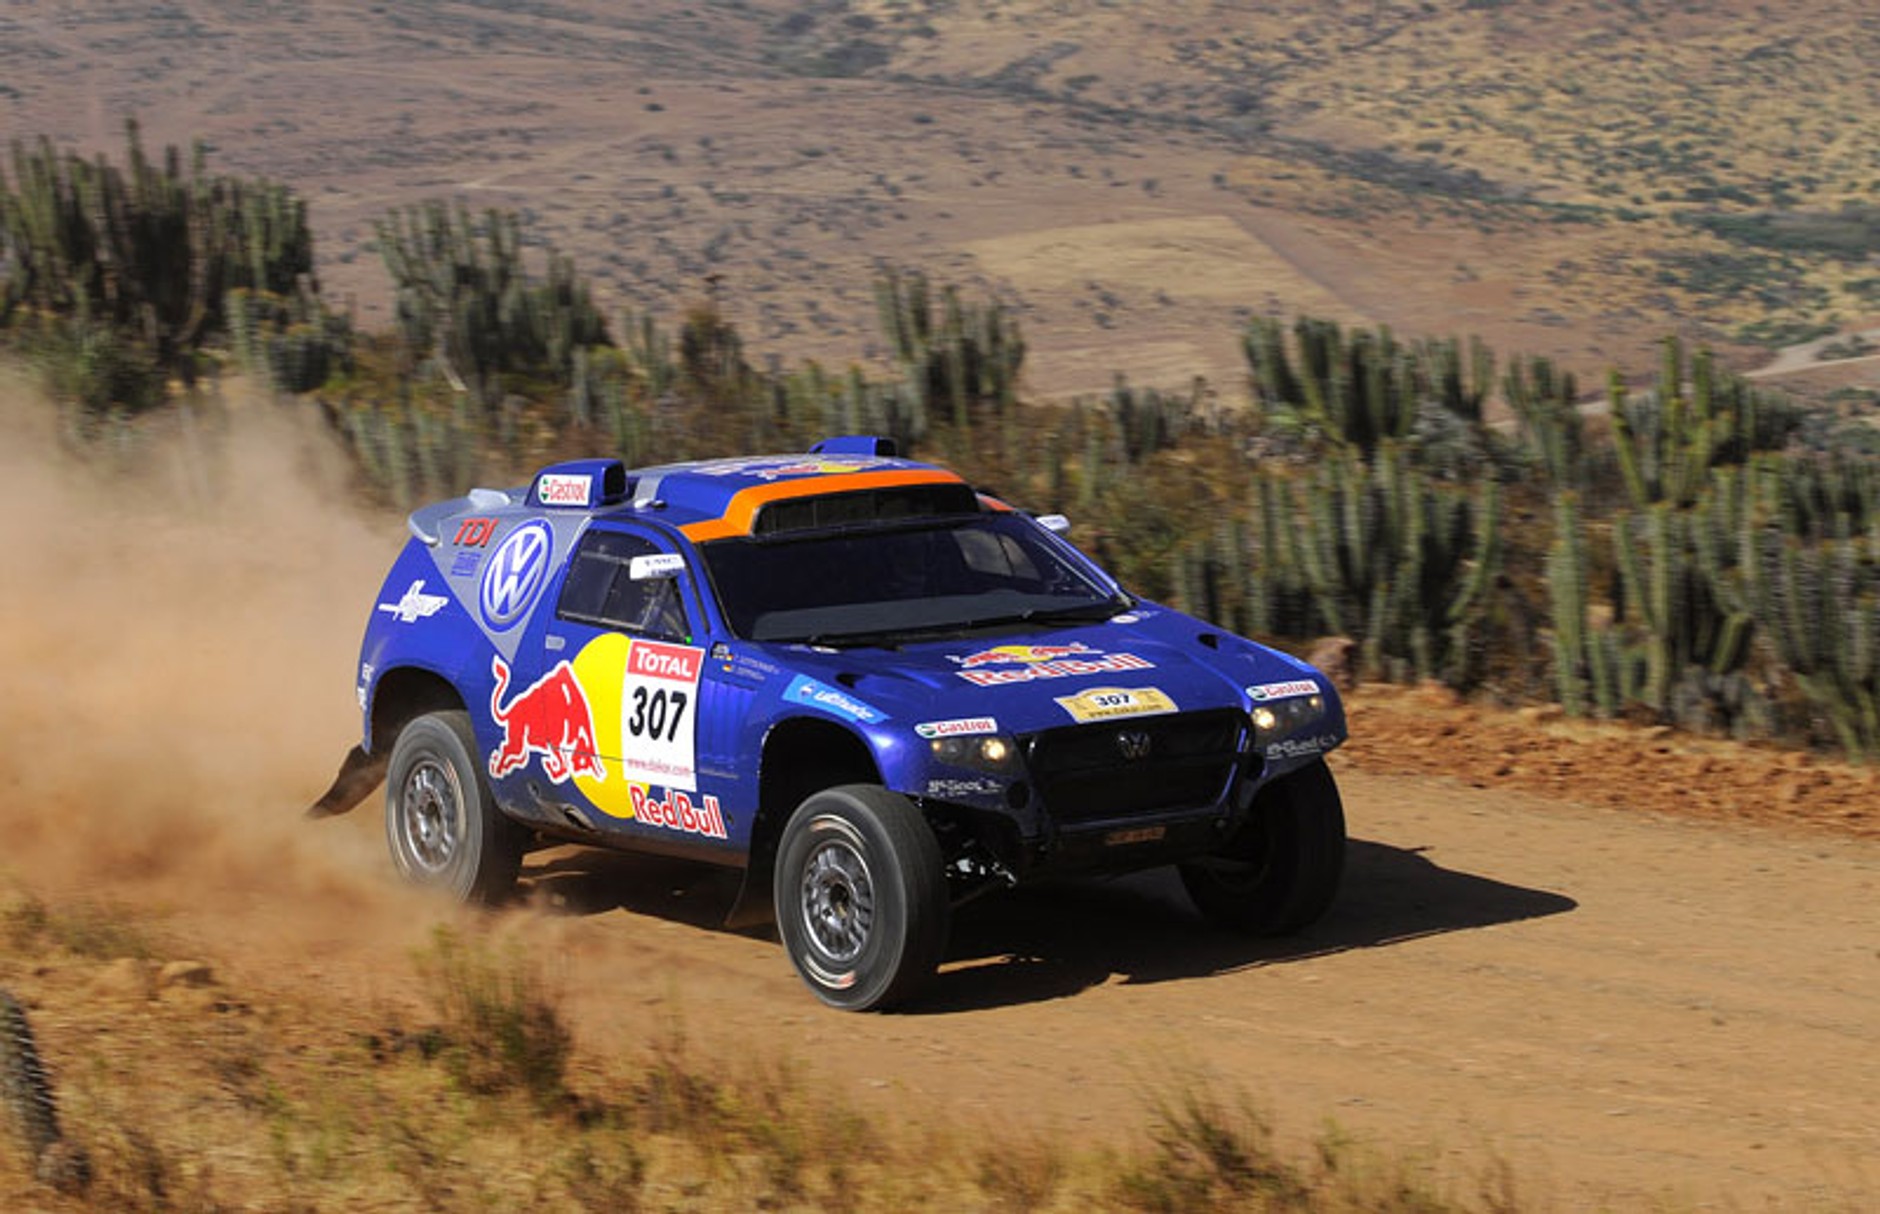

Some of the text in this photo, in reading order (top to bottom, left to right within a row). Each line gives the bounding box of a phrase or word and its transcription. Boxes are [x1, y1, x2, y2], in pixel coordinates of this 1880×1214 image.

[454, 518, 498, 546] TDI
[635, 648, 693, 677] TOTAL
[1094, 693, 1131, 706] 307
[629, 685, 687, 743] 307
